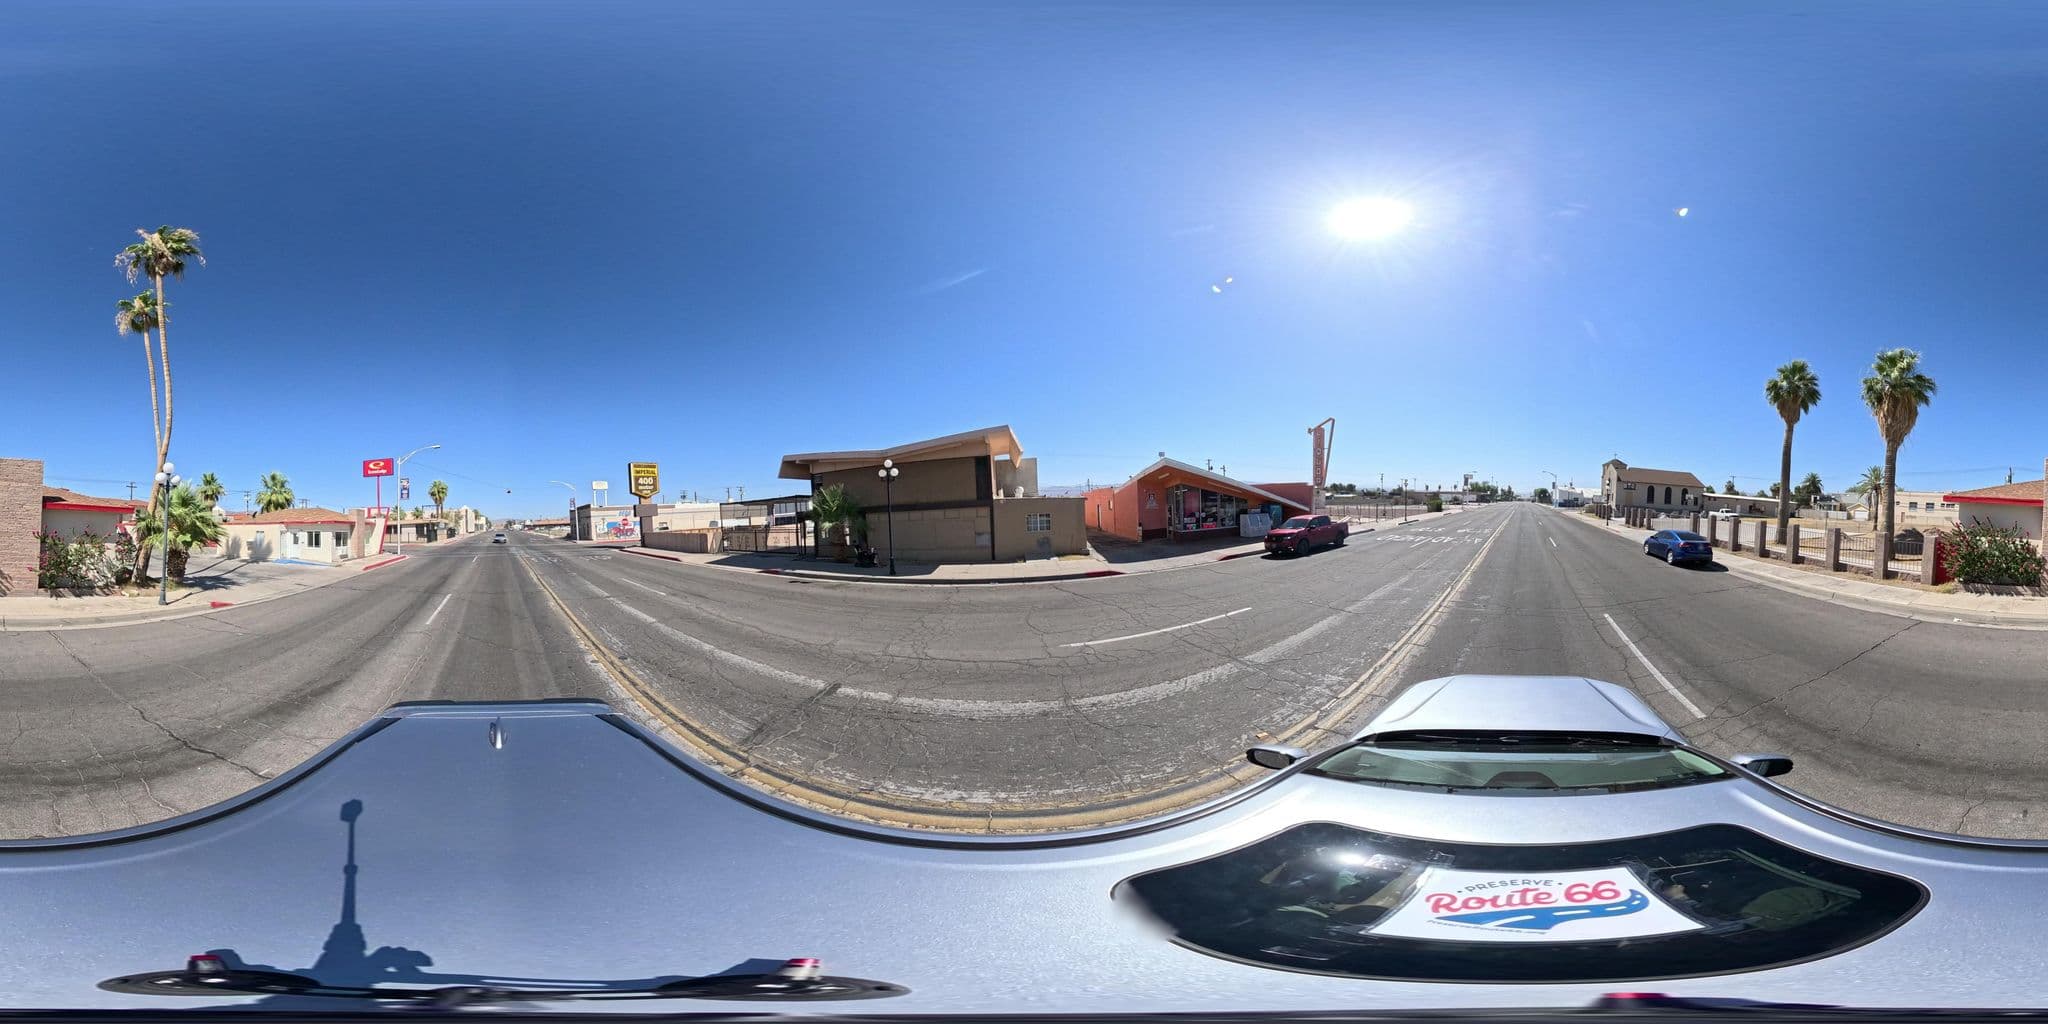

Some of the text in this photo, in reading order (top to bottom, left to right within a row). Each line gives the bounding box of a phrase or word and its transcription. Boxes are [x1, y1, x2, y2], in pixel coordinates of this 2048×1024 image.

[638, 477, 654, 485] 400
[1464, 879, 1554, 893] PRESERVE
[1425, 881, 1621, 914] Route 66
